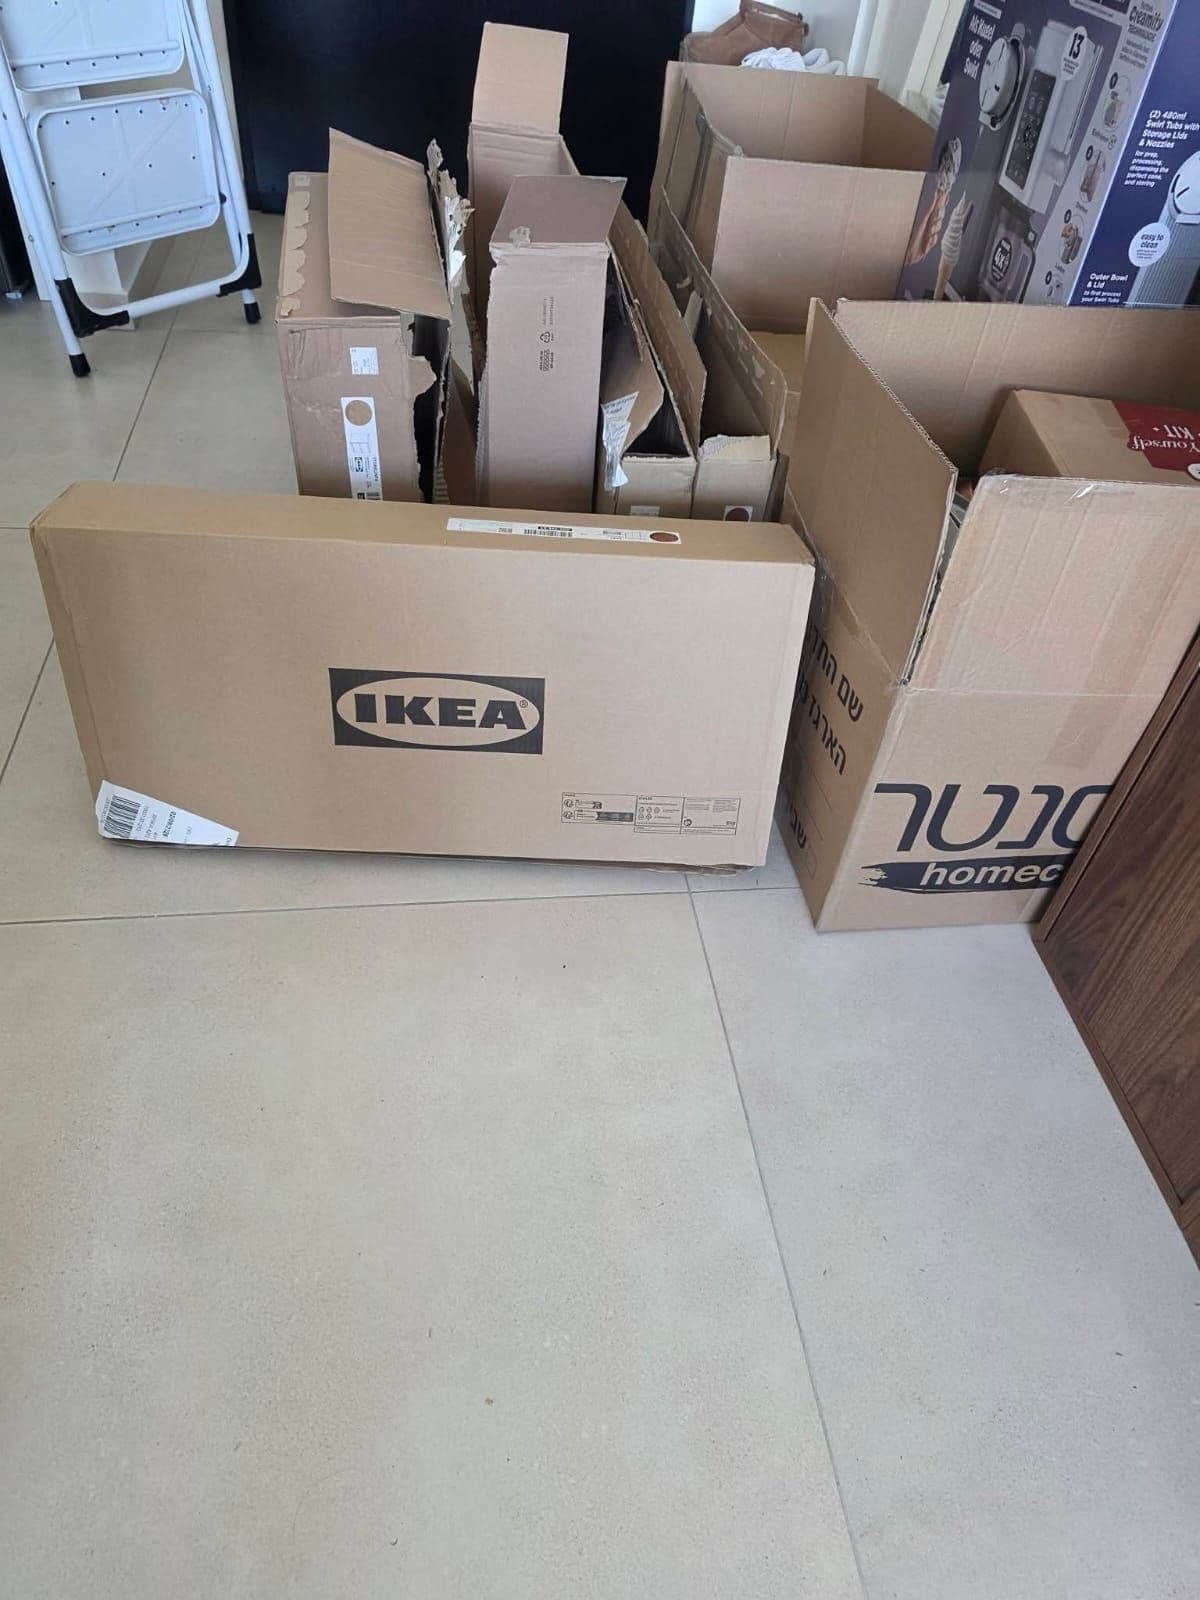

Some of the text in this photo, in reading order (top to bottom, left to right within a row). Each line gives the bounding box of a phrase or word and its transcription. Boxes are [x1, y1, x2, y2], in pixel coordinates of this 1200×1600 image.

[1069, 32, 1084, 59] 13
[1150, 110, 1187, 121] (2) 480ml
[1146, 120, 1200, 131] Swirl Tubs with
[1142, 129, 1188, 140] Storage Lids
[1146, 140, 1175, 148] Nozzles
[1140, 241, 1158, 249] clean
[1090, 273, 1110, 281] Outer
[1164, 424, 1194, 440] KIT
[1132, 436, 1200, 453] Yourself
[837, 674, 864, 722] שם
[354, 693, 527, 730] IKEA
